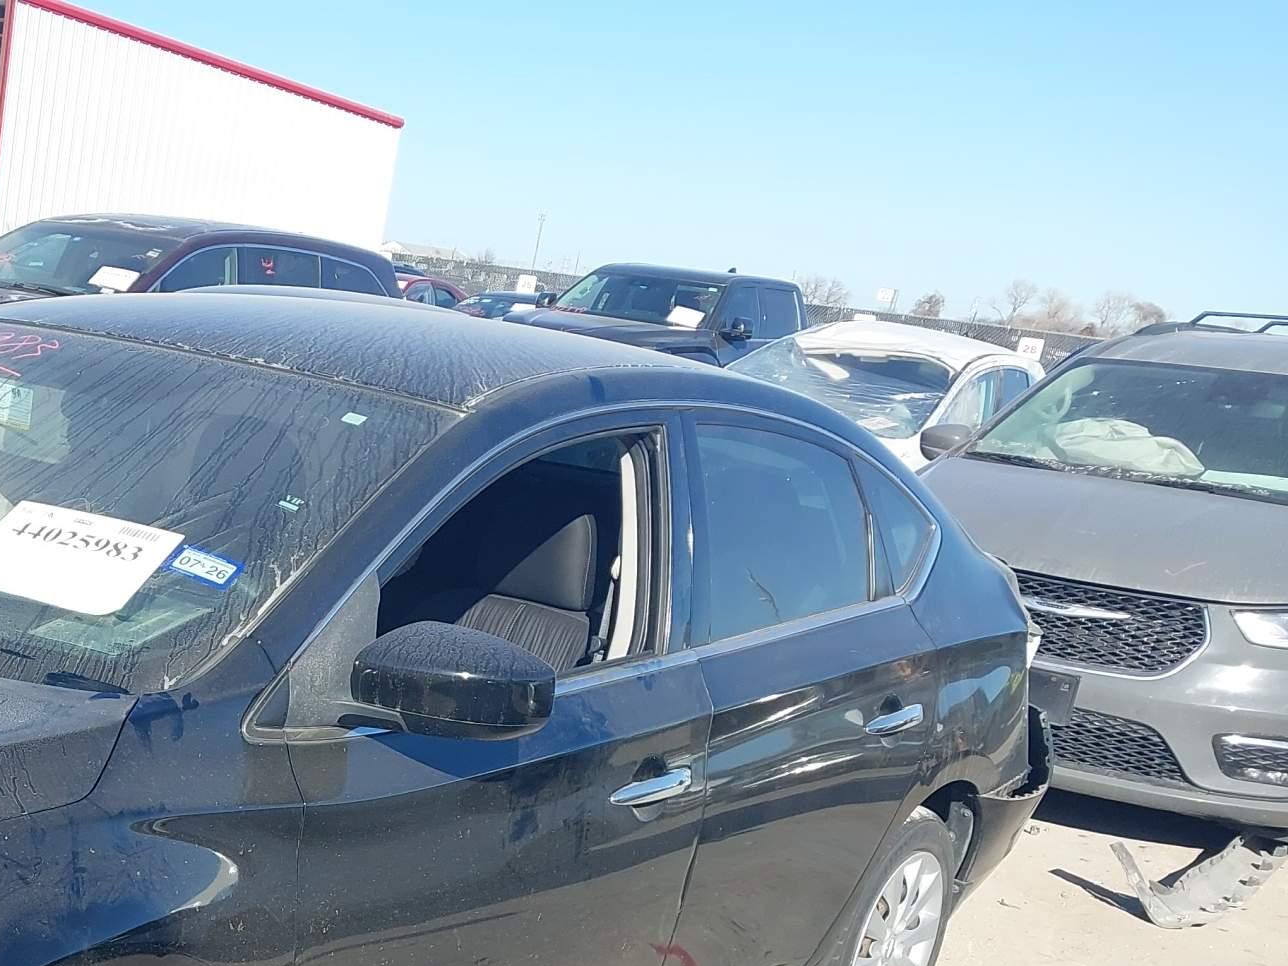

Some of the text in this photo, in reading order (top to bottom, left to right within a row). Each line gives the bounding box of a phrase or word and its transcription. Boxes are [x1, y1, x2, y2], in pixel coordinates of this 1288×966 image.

[12, 521, 144, 561] 44025983
[179, 555, 201, 568] 07
[206, 565, 229, 580] 26
